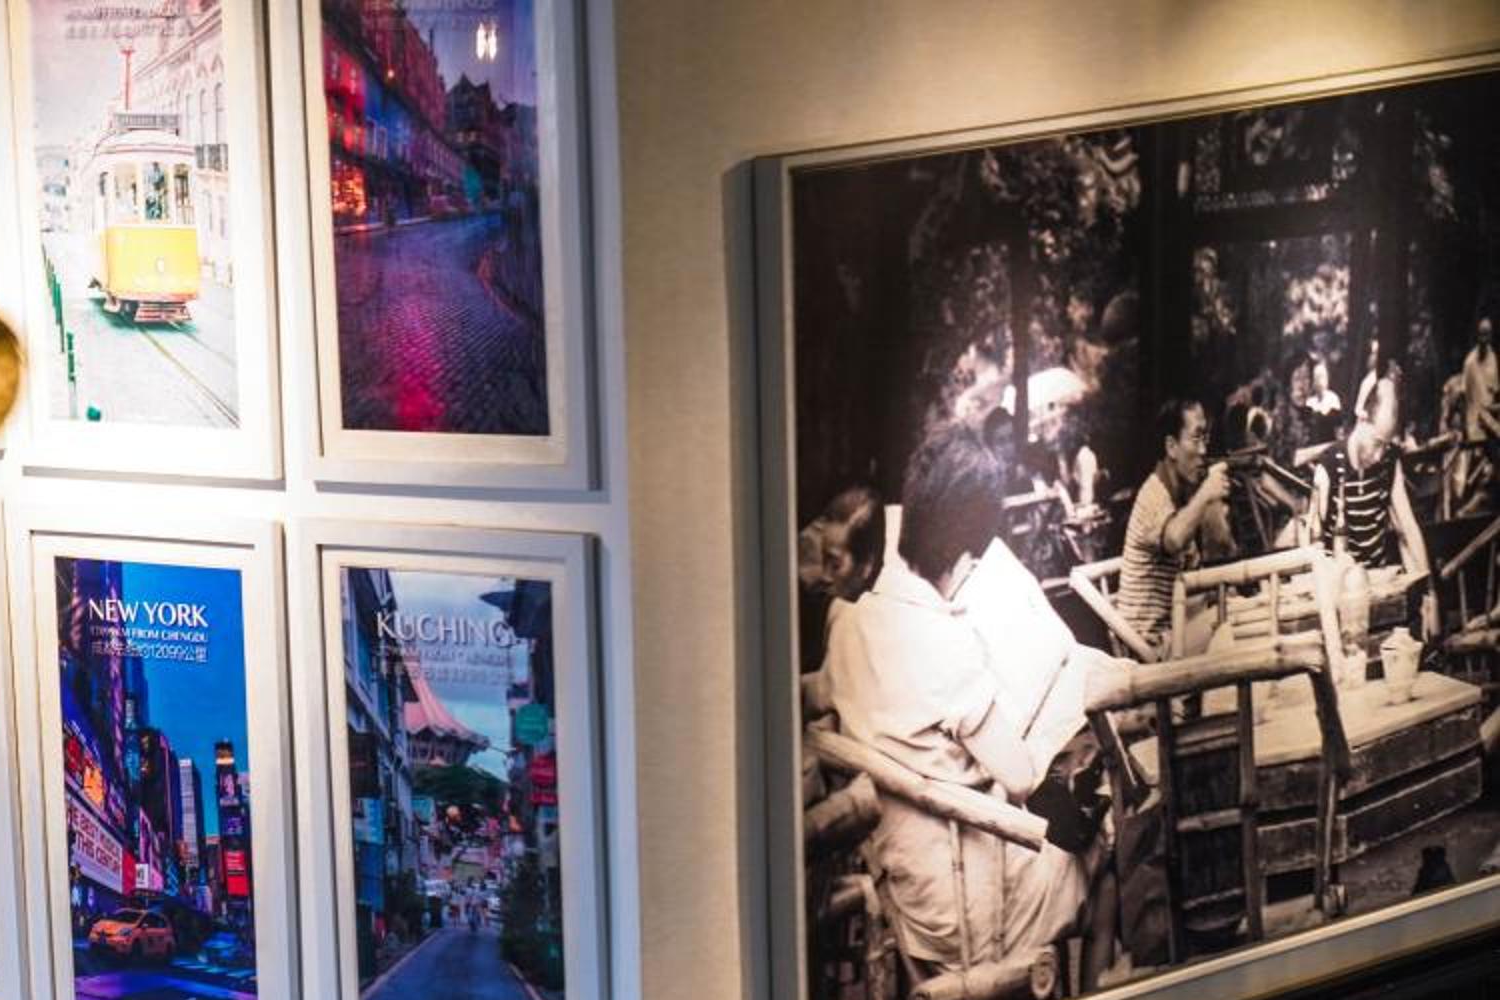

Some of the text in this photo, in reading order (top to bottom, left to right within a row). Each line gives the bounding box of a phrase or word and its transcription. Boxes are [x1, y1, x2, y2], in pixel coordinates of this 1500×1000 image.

[88, 598, 209, 628] NEW YORK
[376, 611, 517, 648] KUCHING
